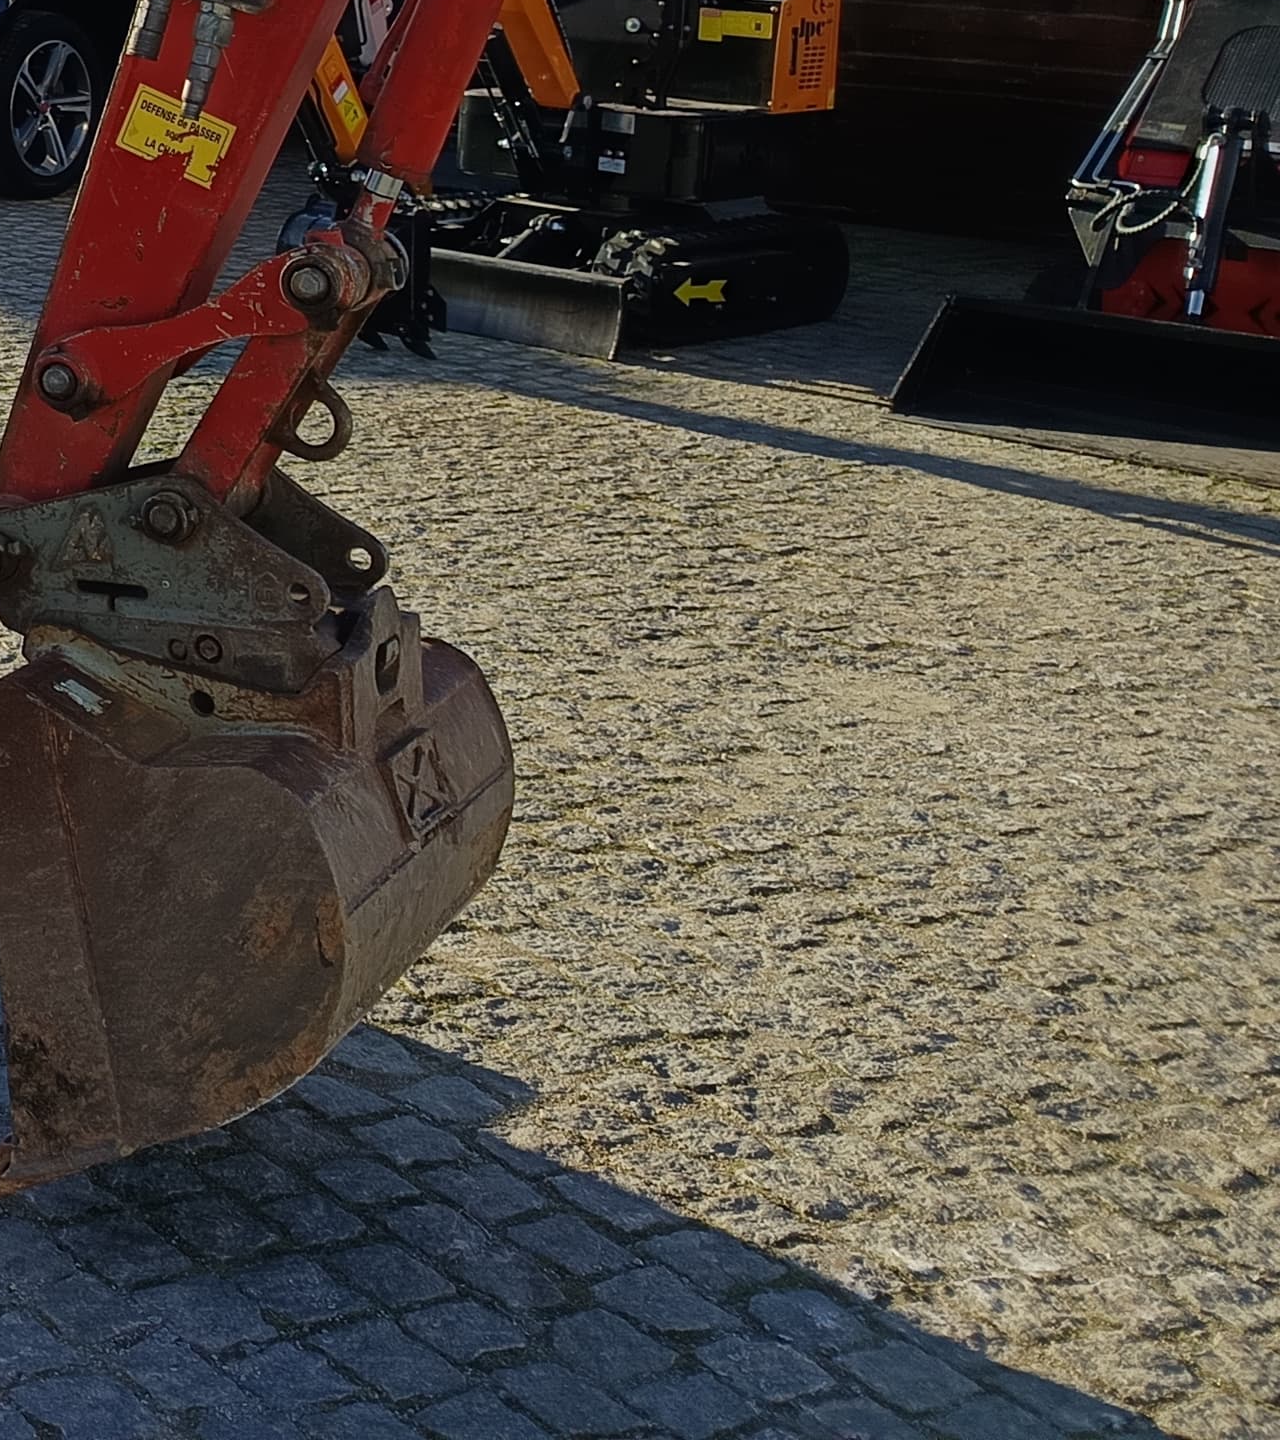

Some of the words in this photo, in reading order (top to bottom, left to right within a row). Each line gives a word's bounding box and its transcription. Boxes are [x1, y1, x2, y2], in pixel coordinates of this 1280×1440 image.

[140, 99, 177, 125] DEFENSE
[190, 120, 222, 145] PASSER
[144, 136, 156, 149] LA
